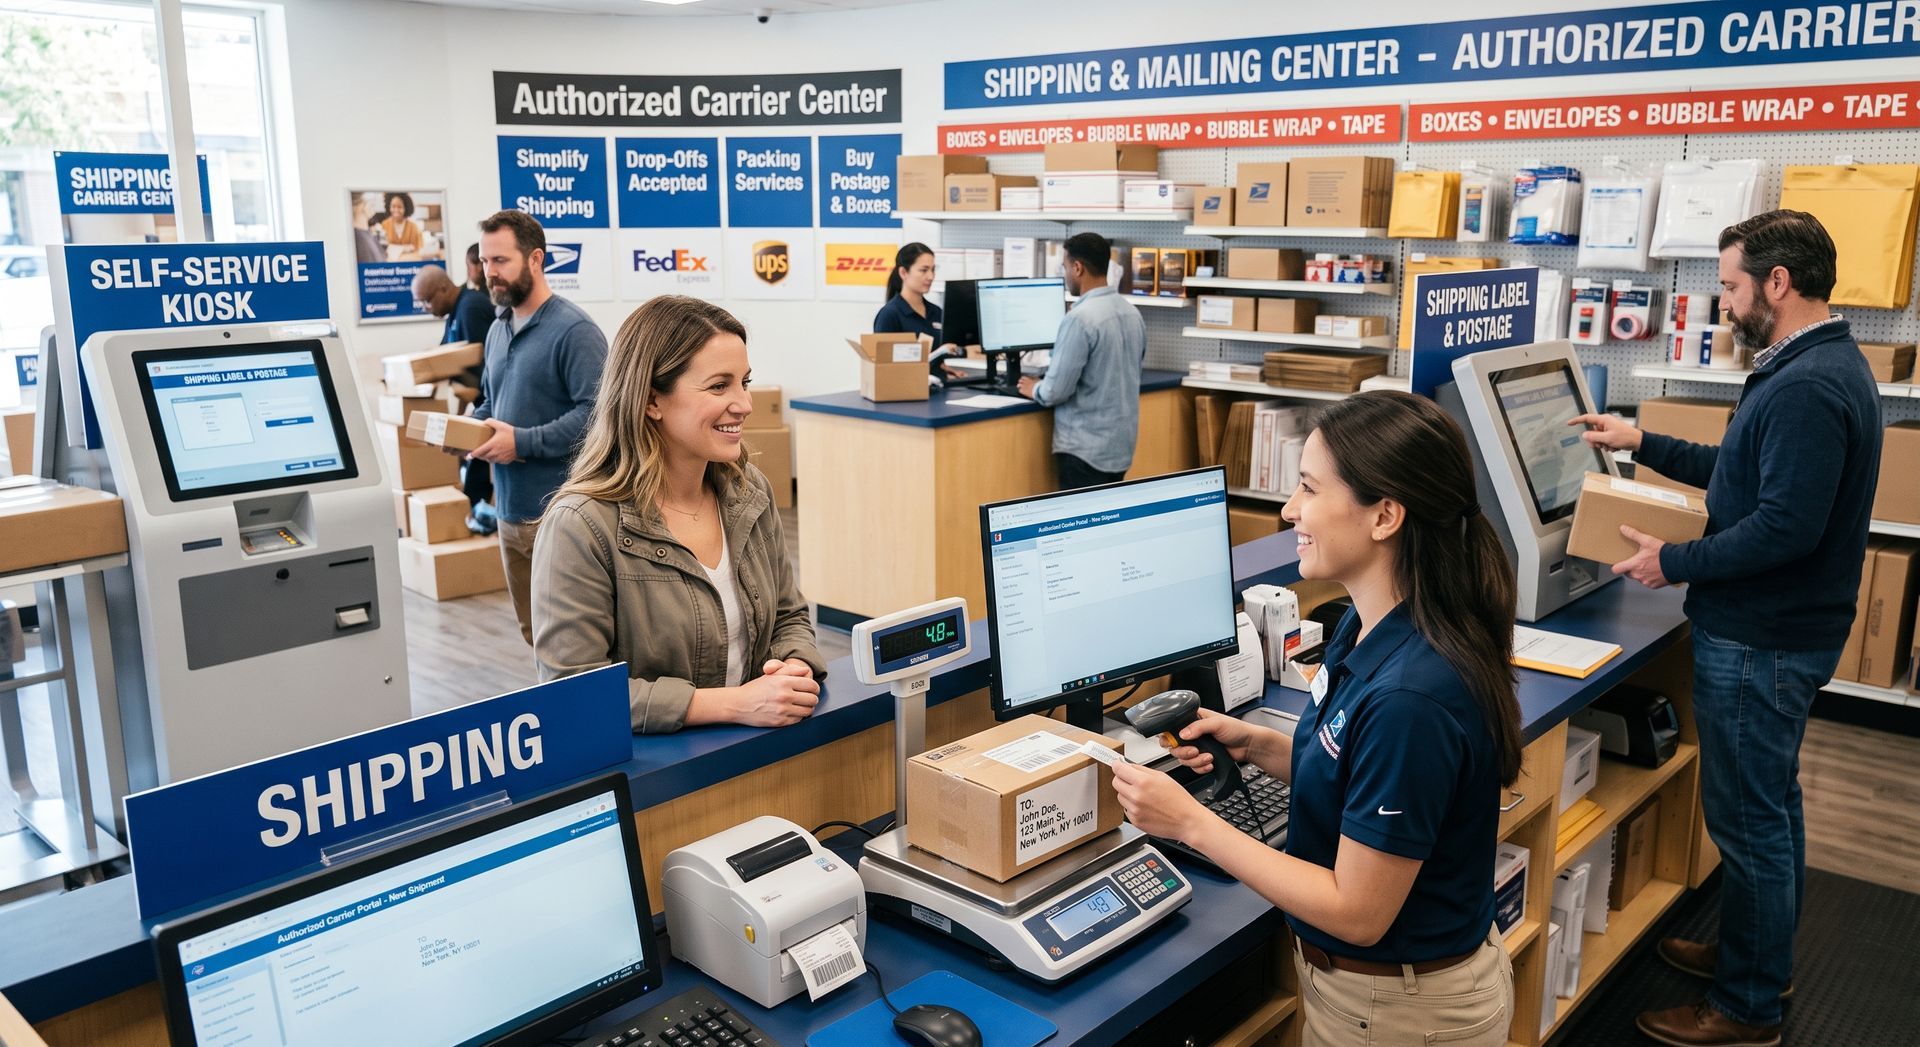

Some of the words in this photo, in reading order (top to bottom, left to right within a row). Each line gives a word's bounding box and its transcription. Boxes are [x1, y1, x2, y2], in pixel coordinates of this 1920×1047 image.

[983, 60, 1101, 99] SHIPPING
[1109, 59, 1130, 91] &
[1137, 50, 1262, 89] MAILING
[1270, 38, 1400, 83] CENTER
[1452, 14, 1705, 71] AUTHORIZED
[1719, 0, 1920, 53] CARRIER
[512, 82, 682, 117] Authorized
[691, 85, 791, 116] Carrier
[797, 83, 888, 114] Center
[1420, 111, 1482, 133] BOXES
[1504, 105, 1622, 130] ENVELOPES
[1646, 100, 1735, 126] BUBBLE
[1742, 97, 1815, 121] WRAP
[1843, 93, 1908, 118] TAPE
[946, 130, 987, 148] BOXES
[999, 126, 1073, 146] ENVELOPES
[1087, 122, 1143, 143] BUBBLE
[1146, 122, 1191, 141] WRAP
[1207, 118, 1268, 139] BUBBLE
[1273, 116, 1322, 138] WRAP
[1341, 114, 1386, 135] TAPE
[516, 148, 589, 171] Simplify
[625, 150, 709, 171] Drop-Offs
[736, 149, 801, 171] Packing
[845, 148, 875, 171] Buy
[70, 167, 171, 190] SHIPPING
[533, 173, 575, 192] Your
[628, 173, 708, 195] Accepted
[735, 173, 804, 192] Services
[830, 172, 891, 194] Postage
[73, 190, 138, 206] CARRIER
[516, 196, 595, 219] Shipping
[830, 197, 843, 214] &
[846, 196, 892, 214] Boxes
[90, 254, 309, 290] SELF-SERVICE
[633, 249, 707, 272] FedEx
[755, 254, 787, 280] ups
[836, 256, 888, 272] DHL
[676, 274, 711, 285] Express
[162, 291, 256, 324] KIOSK
[1426, 284, 1489, 317] SHIPPING
[1491, 281, 1530, 309] LABEL
[1443, 321, 1454, 348] &
[1457, 313, 1513, 346] POSTAGE
[184, 374, 221, 385] SHIPPING
[222, 371, 246, 381] LABEL
[247, 371, 254, 380] &
[254, 367, 288, 379] POSTAGE
[258, 712, 544, 848] SHIPPING
[1020, 799, 1034, 811] TO:
[1020, 811, 1040, 825] John
[1020, 823, 1034, 837] 123
[1036, 815, 1055, 831] Main
[1056, 811, 1065, 822] St
[1020, 837, 1037, 851] New
[1039, 827, 1058, 842] York,
[1060, 819, 1071, 832] NY
[1072, 810, 1094, 826] 10001
[357, 897, 382, 914] Portal
[389, 891, 407, 903] New
[408, 875, 445, 895] Shipment
[419, 943, 434, 953] John
[421, 951, 432, 960] 123
